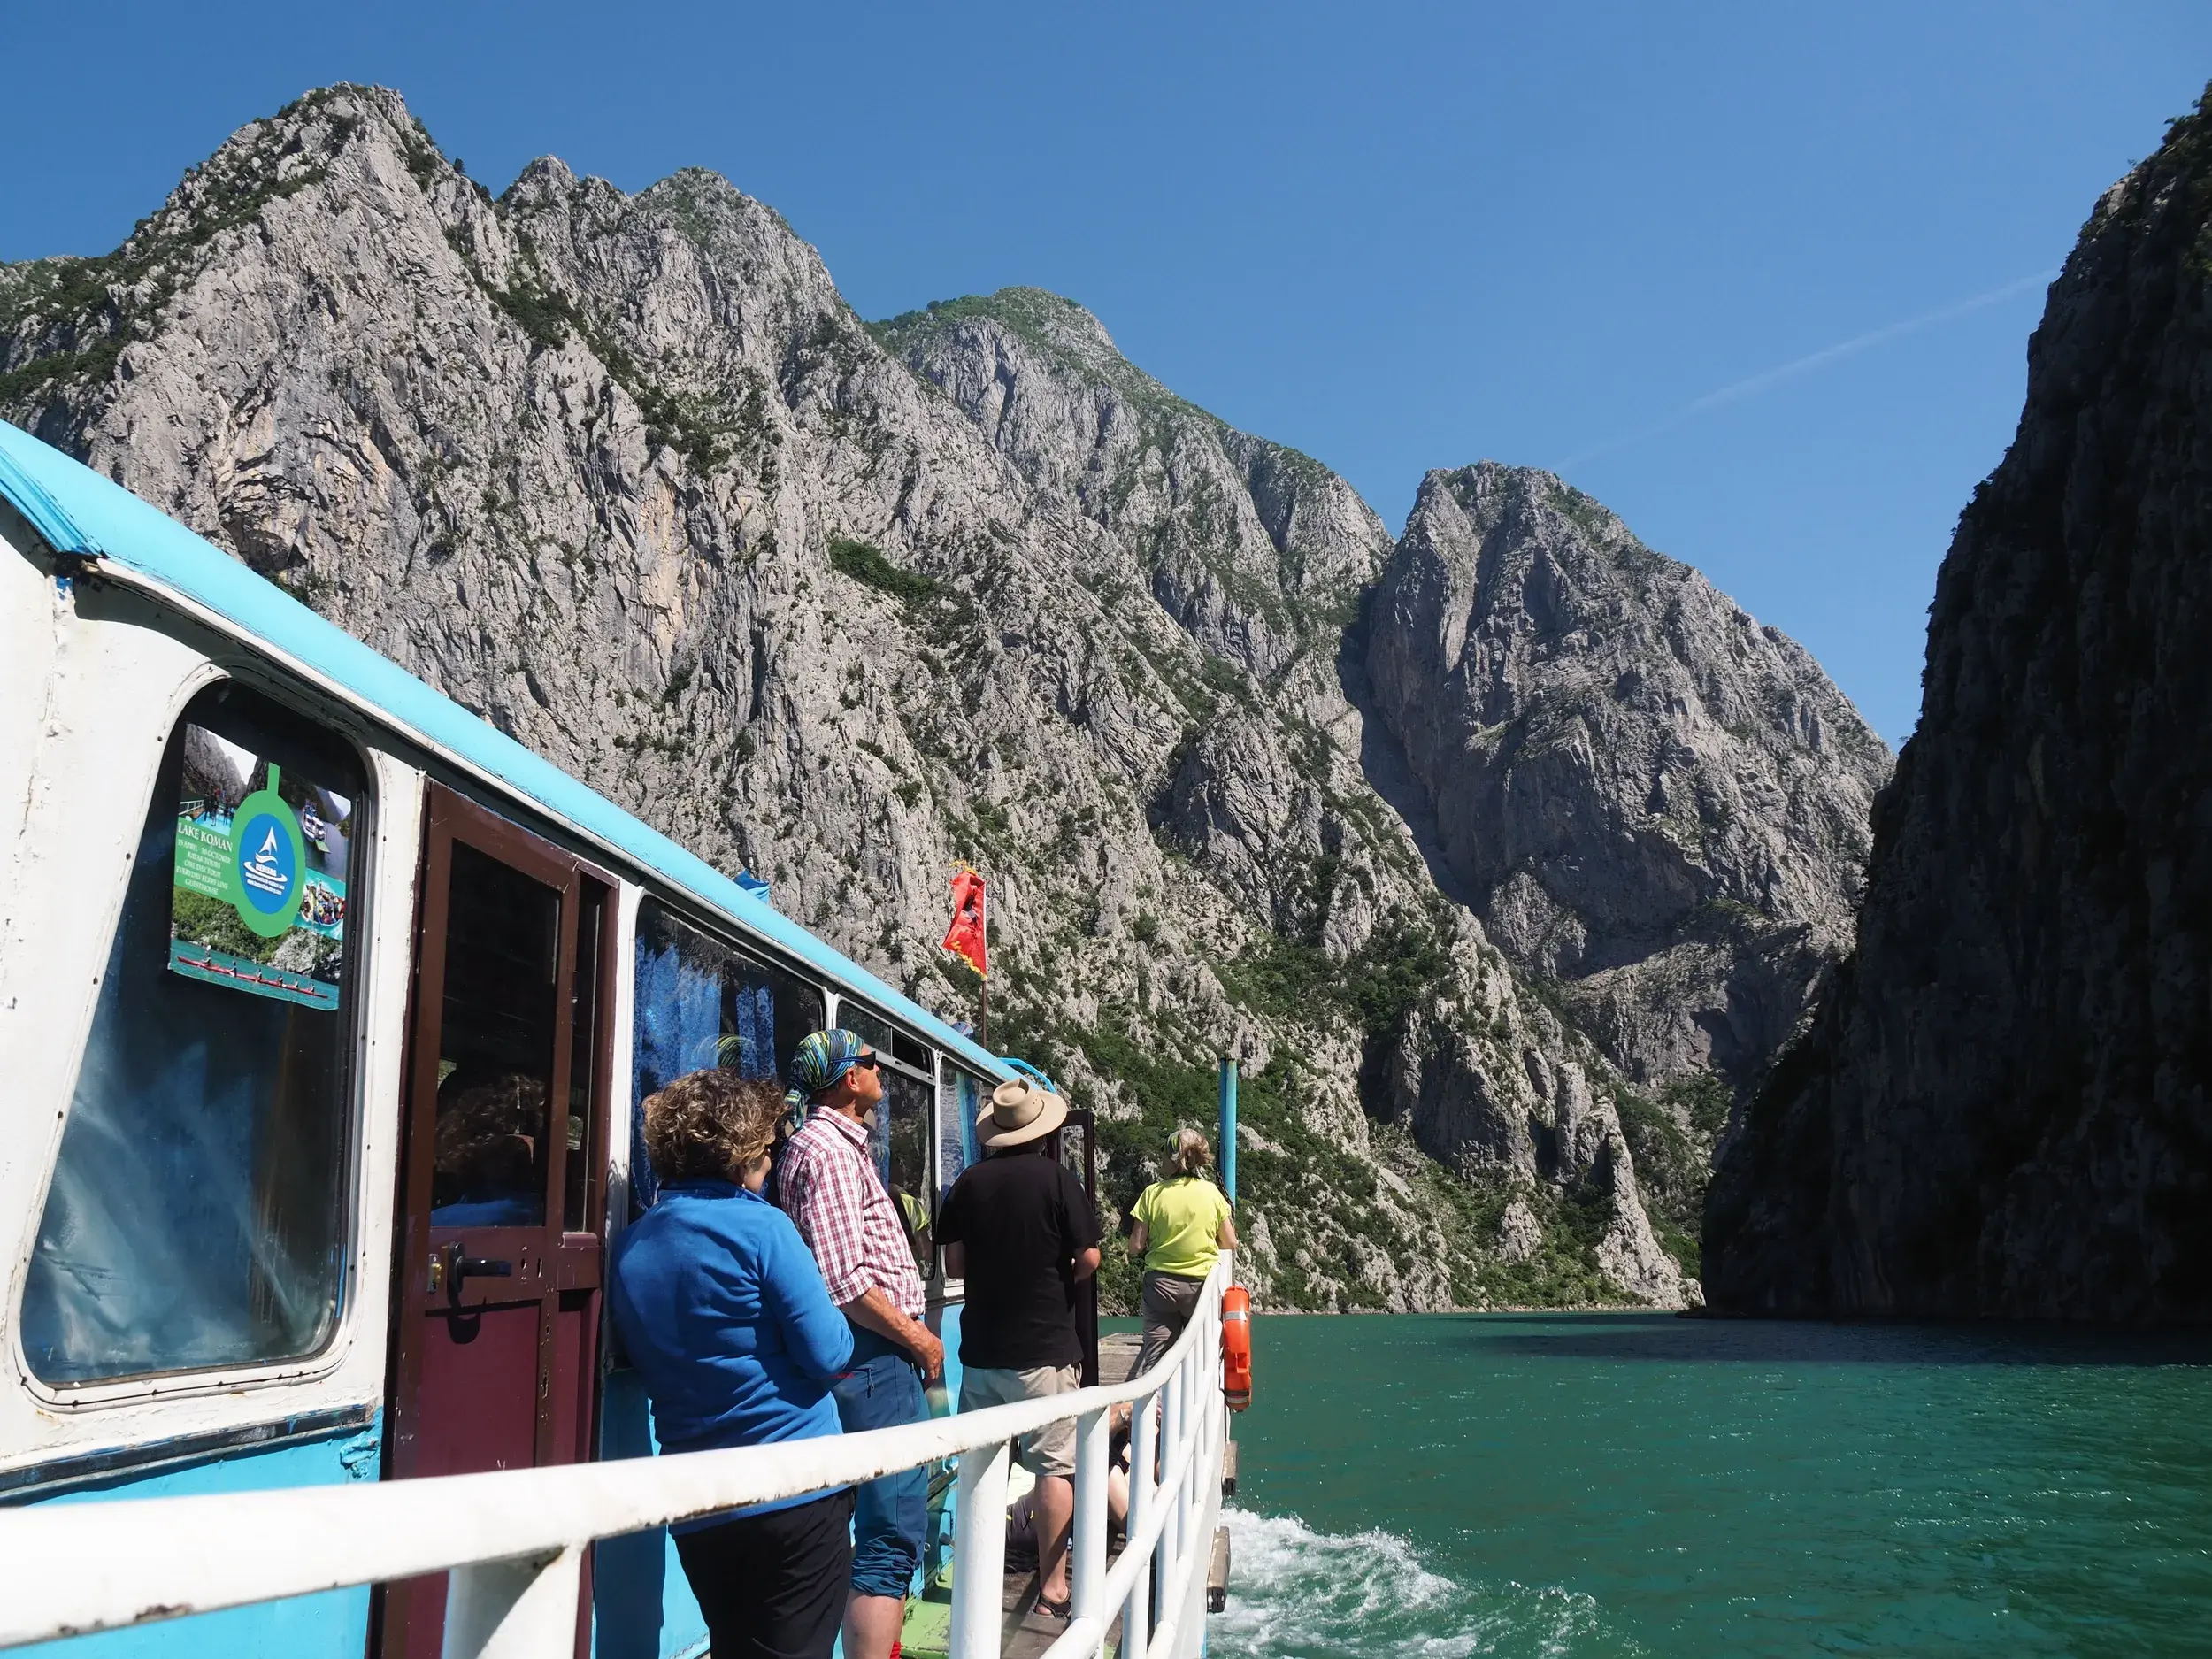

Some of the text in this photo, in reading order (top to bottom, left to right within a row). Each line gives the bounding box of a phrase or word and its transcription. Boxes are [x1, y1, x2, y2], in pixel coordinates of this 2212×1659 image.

[177, 822, 233, 852] LAKE KOMAN
[183, 841, 198, 852] APRIL
[208, 850, 231, 864] OCTOBER
[204, 857, 221, 869] TOURS
[207, 867, 222, 878] TOUR
[176, 865, 228, 889] EVERYDAY FERRY LINE
[185, 879, 219, 894] GUESTHOUSE
